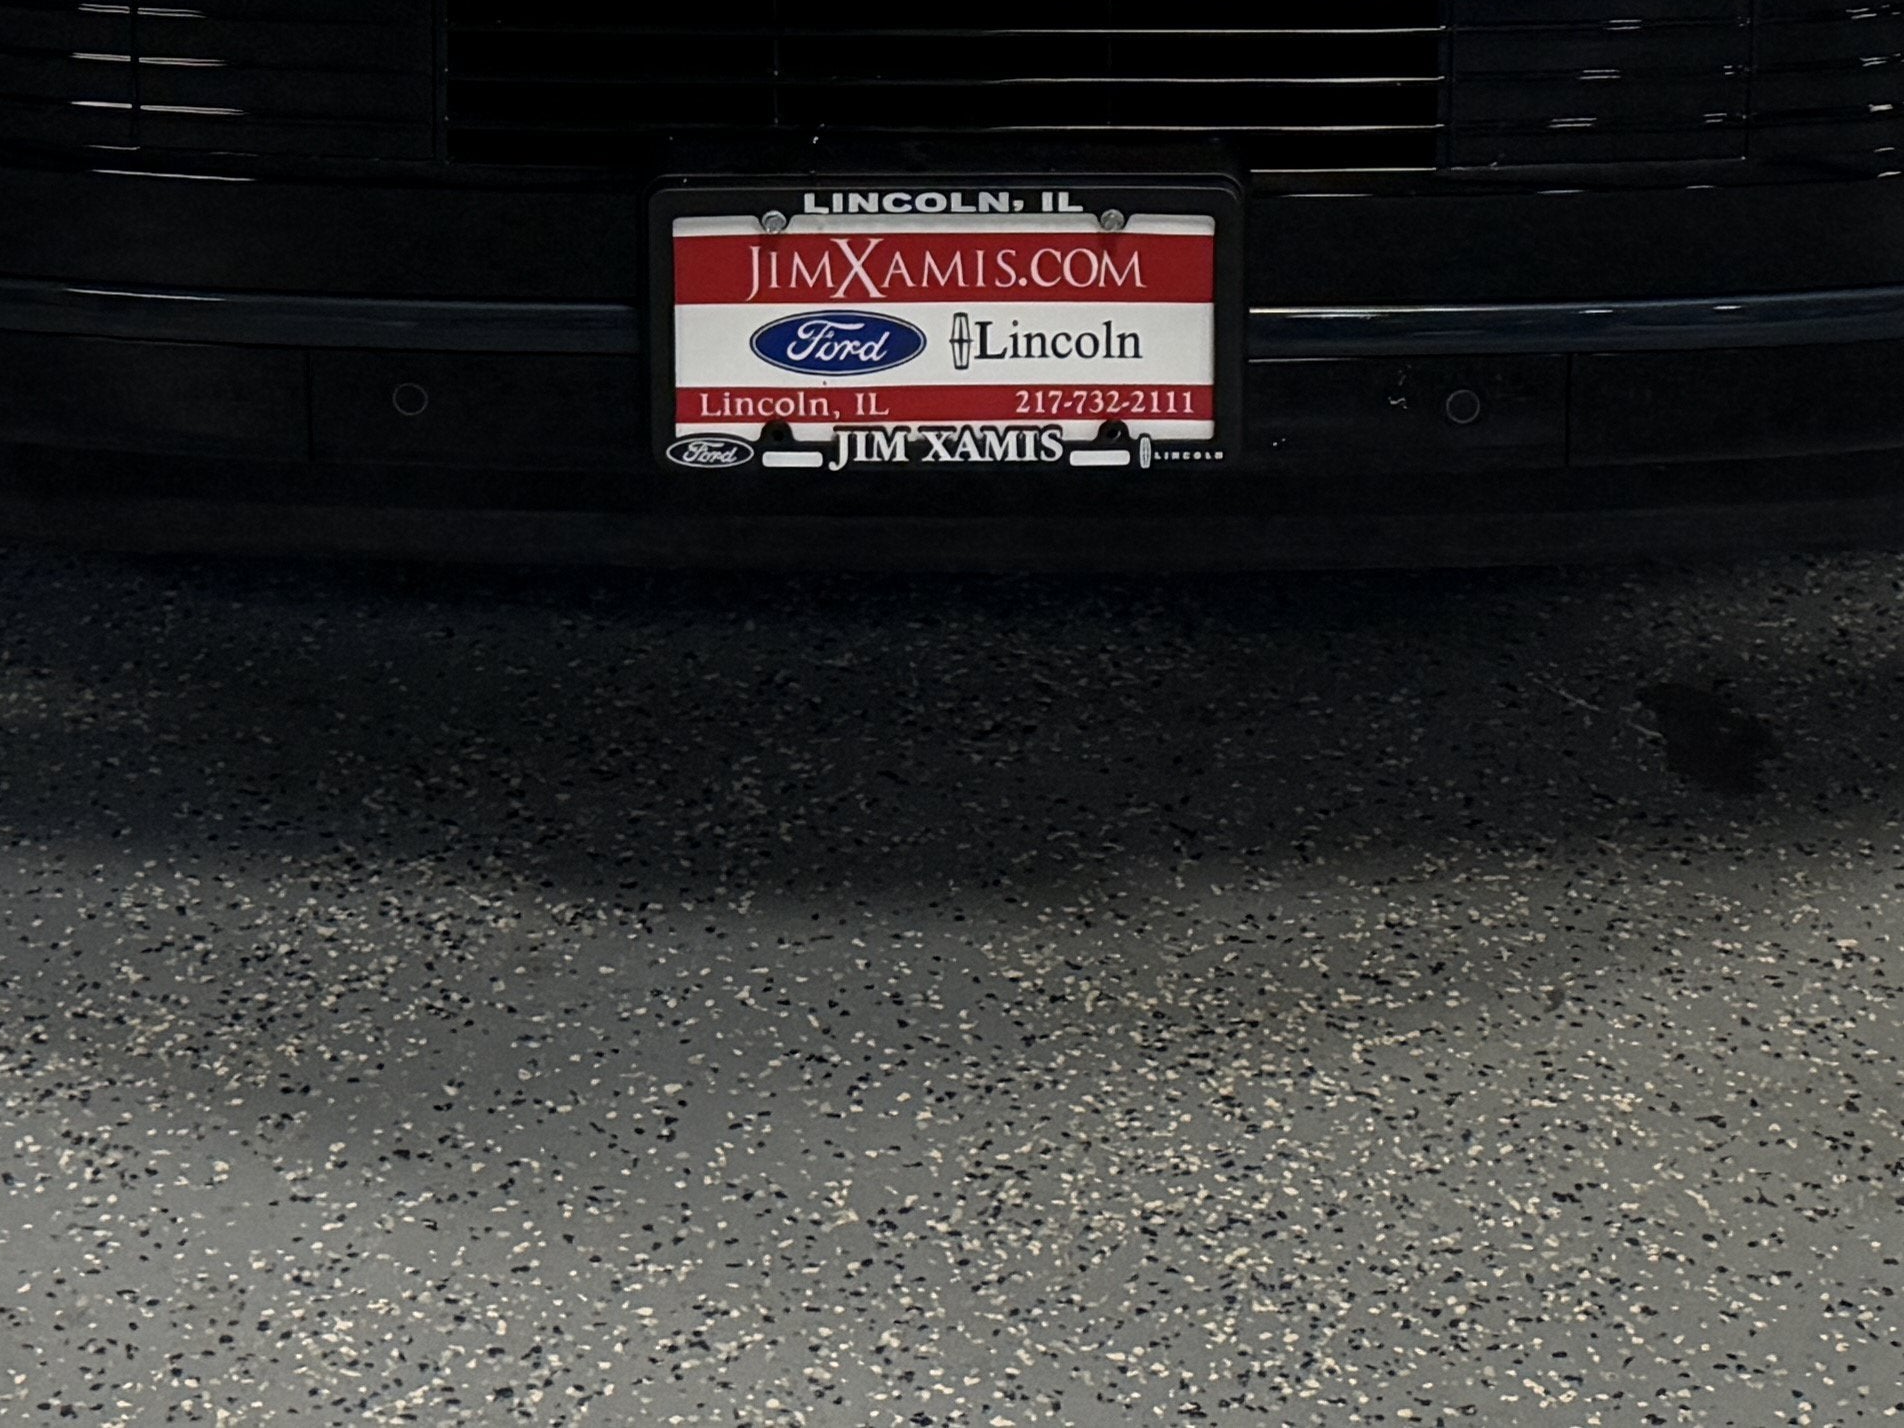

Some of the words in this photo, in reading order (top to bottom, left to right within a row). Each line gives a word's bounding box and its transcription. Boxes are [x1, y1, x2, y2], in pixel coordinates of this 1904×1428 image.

[803, 191, 1024, 214] LINCOLN,
[1042, 191, 1083, 213] IL
[746, 238, 1146, 301] JIMXAMIS.COM
[787, 319, 886, 362] Ford
[974, 320, 1142, 360] Lincoln
[700, 392, 840, 419] Lincoln,
[854, 393, 889, 416] IL
[1015, 390, 1194, 414] 217-732-2111
[683, 442, 737, 463] Ford
[829, 431, 913, 471] JIM
[922, 429, 1064, 463] XAMIS
